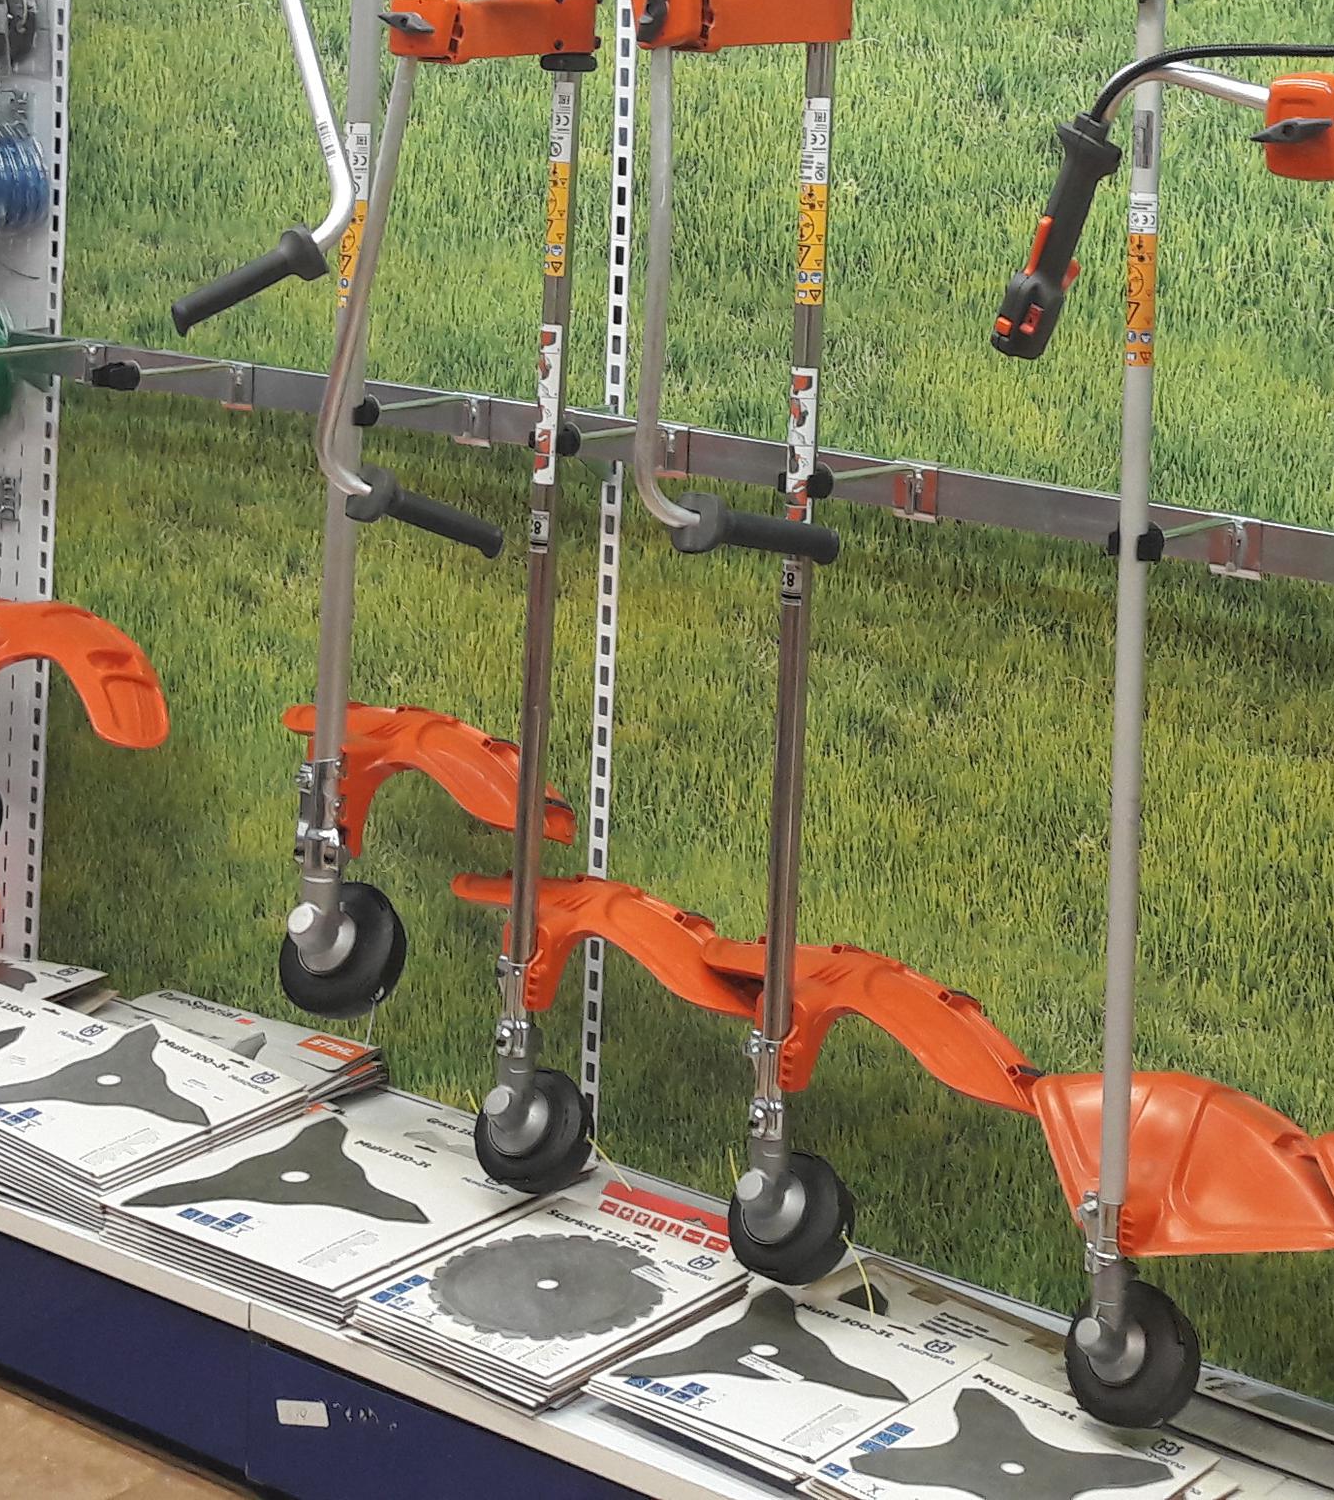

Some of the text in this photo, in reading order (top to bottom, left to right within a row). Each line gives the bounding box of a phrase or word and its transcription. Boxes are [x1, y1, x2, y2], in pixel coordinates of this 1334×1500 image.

[308, 1038, 356, 1058] STIHL
[546, 1208, 603, 1234] Scarlett
[795, 1302, 841, 1321] Multi
[972, 1372, 1019, 1397] Multi
